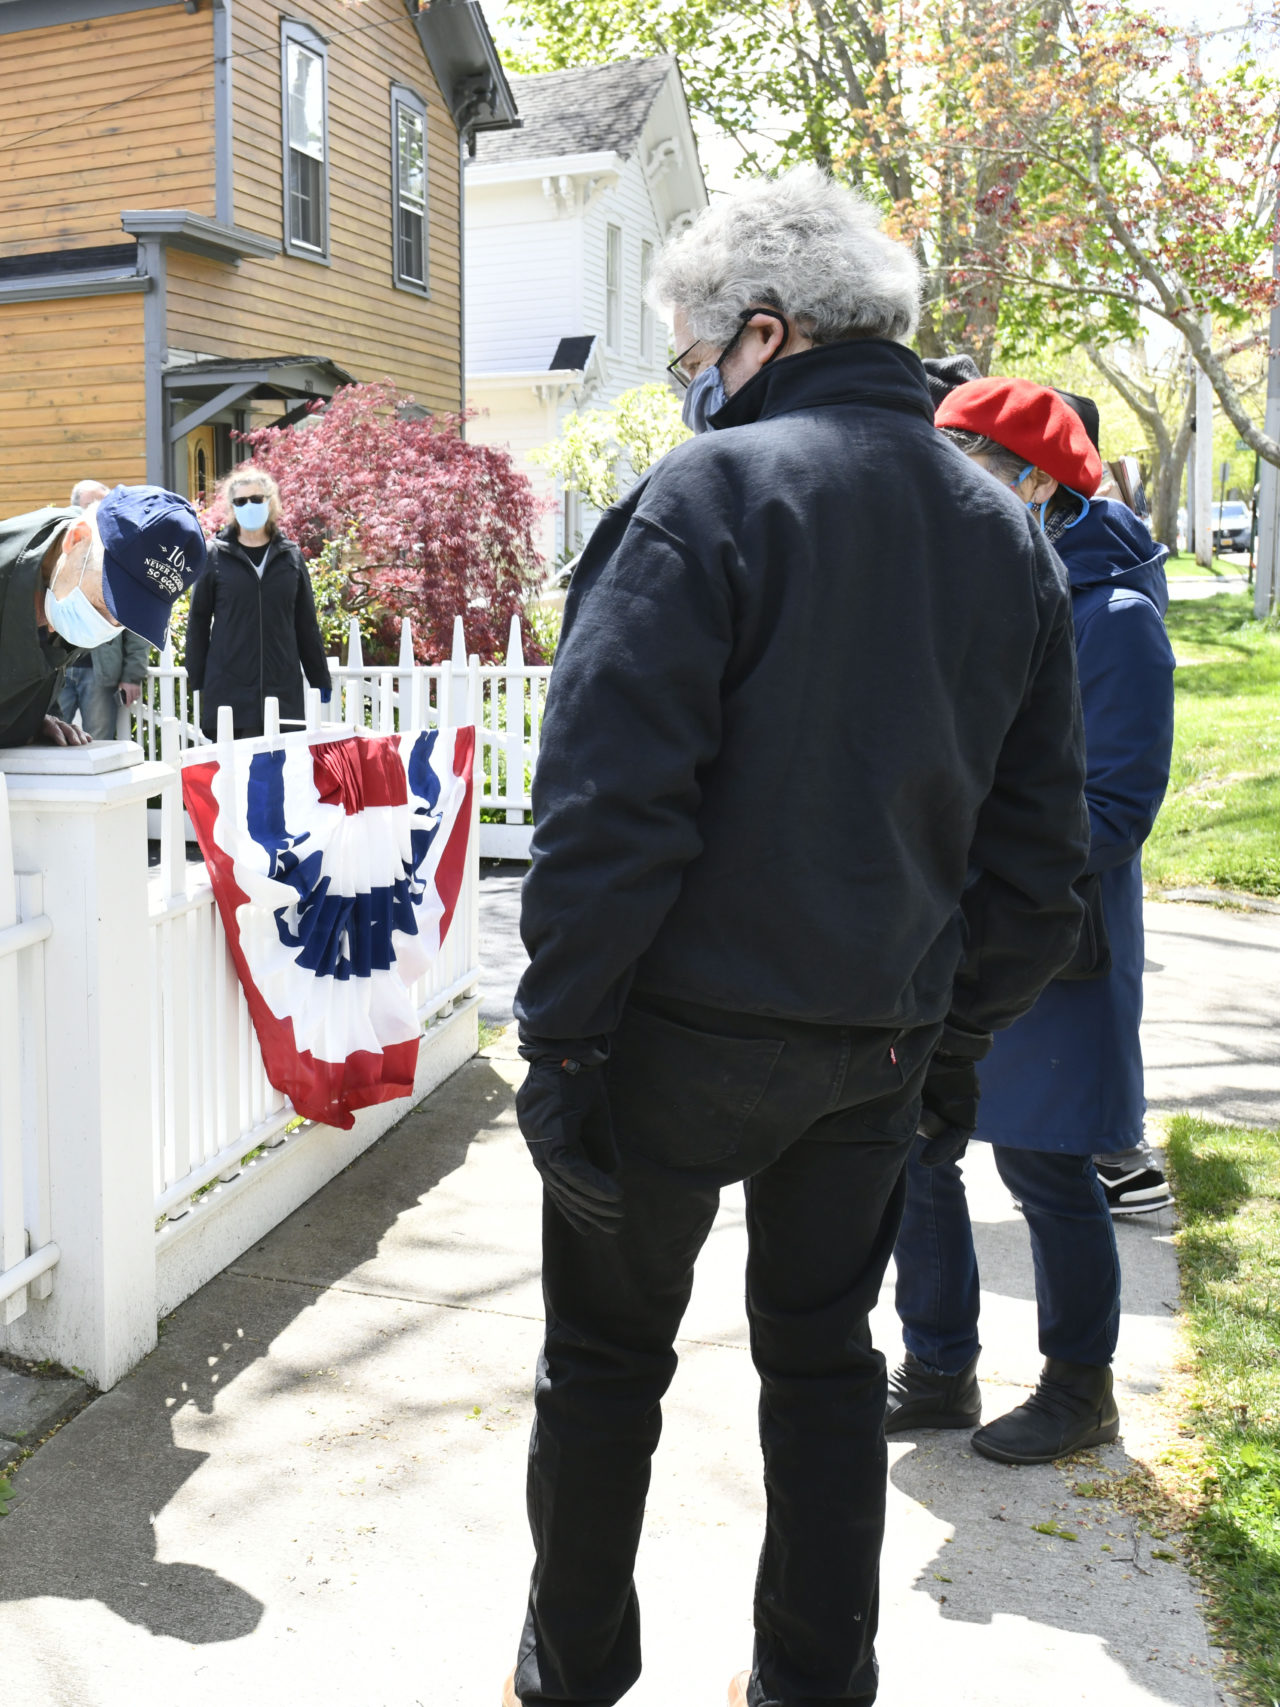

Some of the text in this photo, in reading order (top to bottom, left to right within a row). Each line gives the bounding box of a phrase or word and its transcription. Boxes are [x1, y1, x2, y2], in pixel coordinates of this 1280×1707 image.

[144, 558, 170, 574] NEVER
[147, 568, 177, 592] SO GOOD
